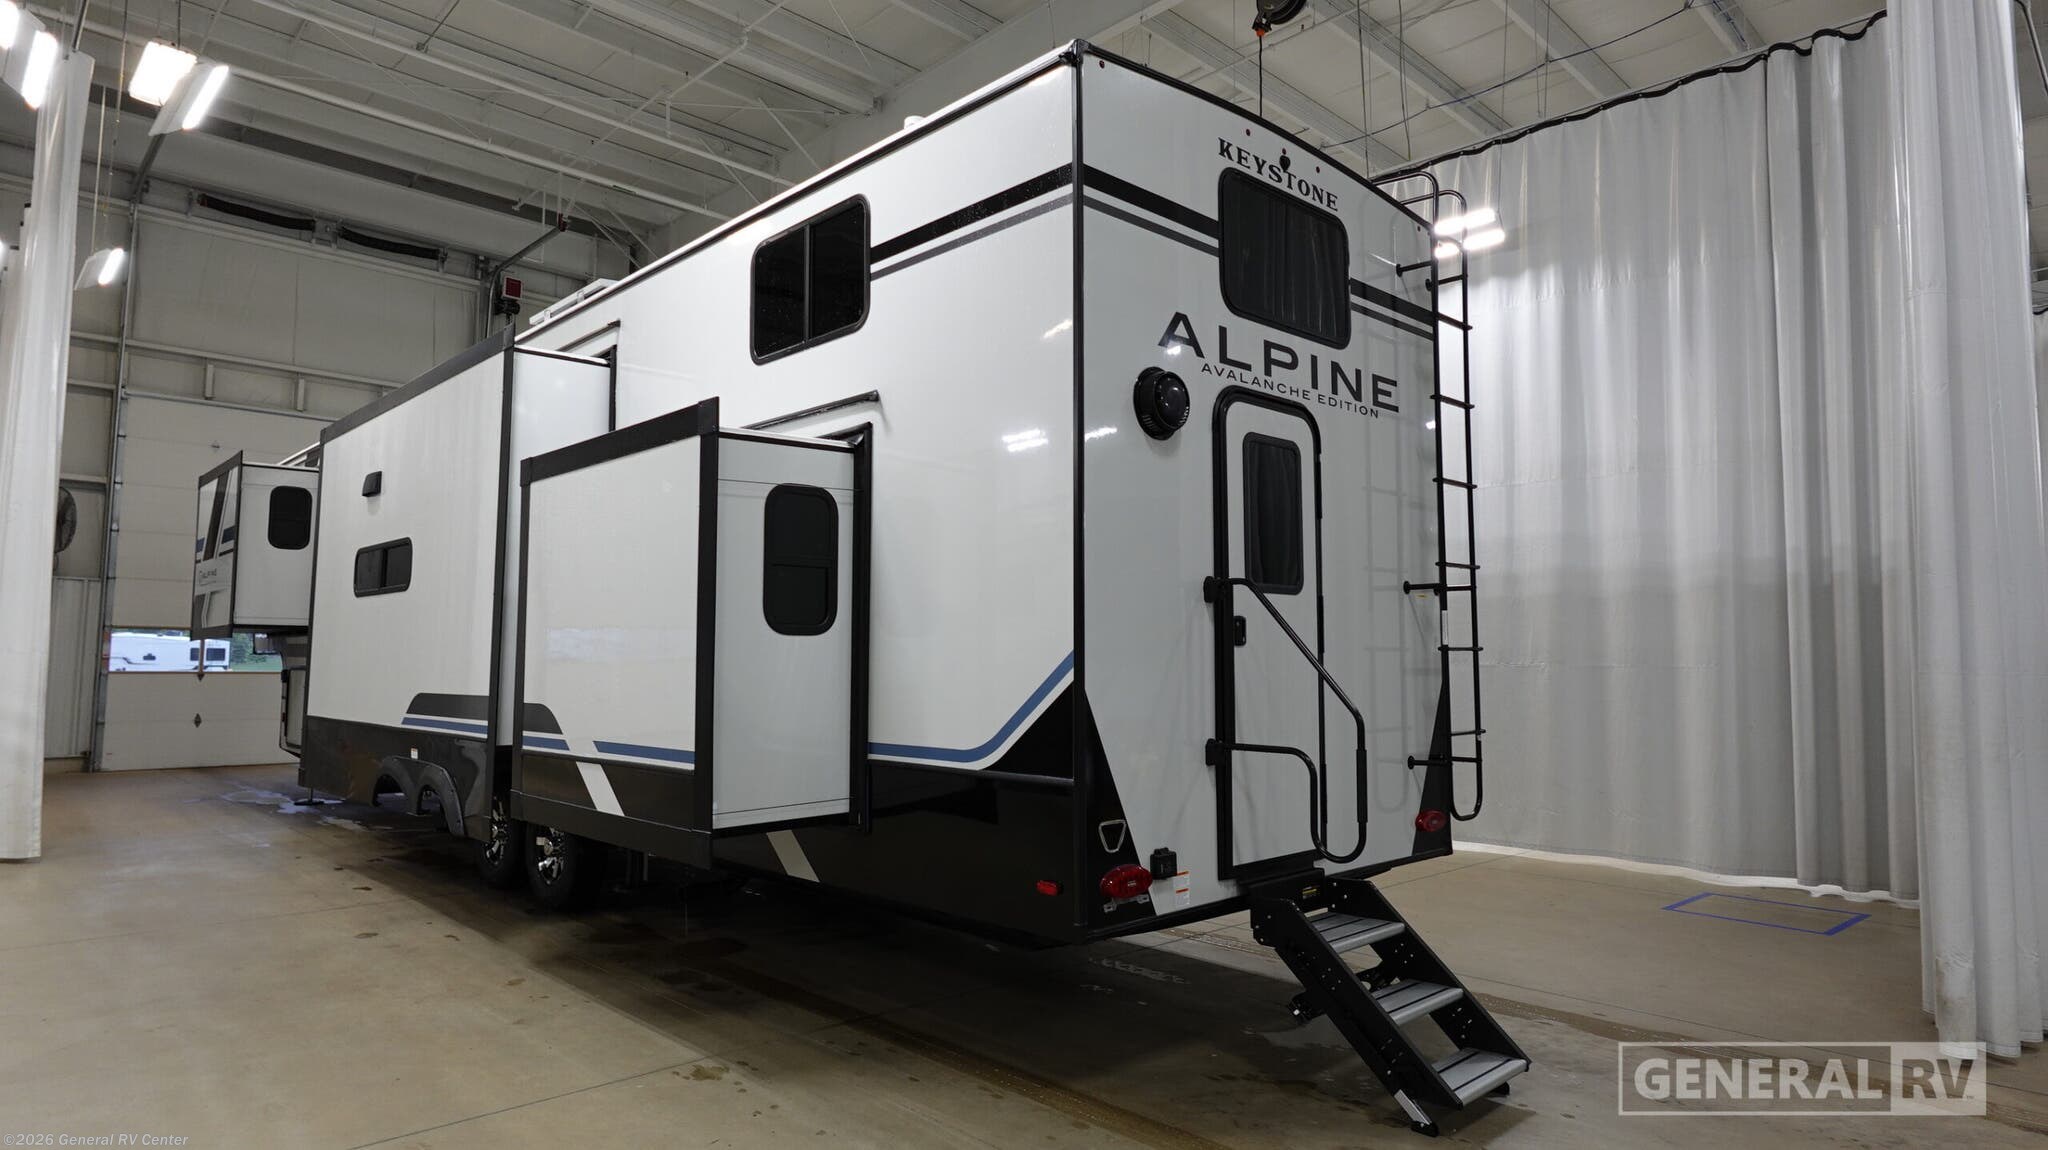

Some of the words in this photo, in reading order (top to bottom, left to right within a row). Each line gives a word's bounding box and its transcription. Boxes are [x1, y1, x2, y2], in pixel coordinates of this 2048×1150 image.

[1218, 137, 1338, 211] KEYSTONE
[1157, 311, 1399, 413] ALPINE
[1201, 362, 1311, 400] AVALANCHE
[1317, 394, 1379, 418] EDITION
